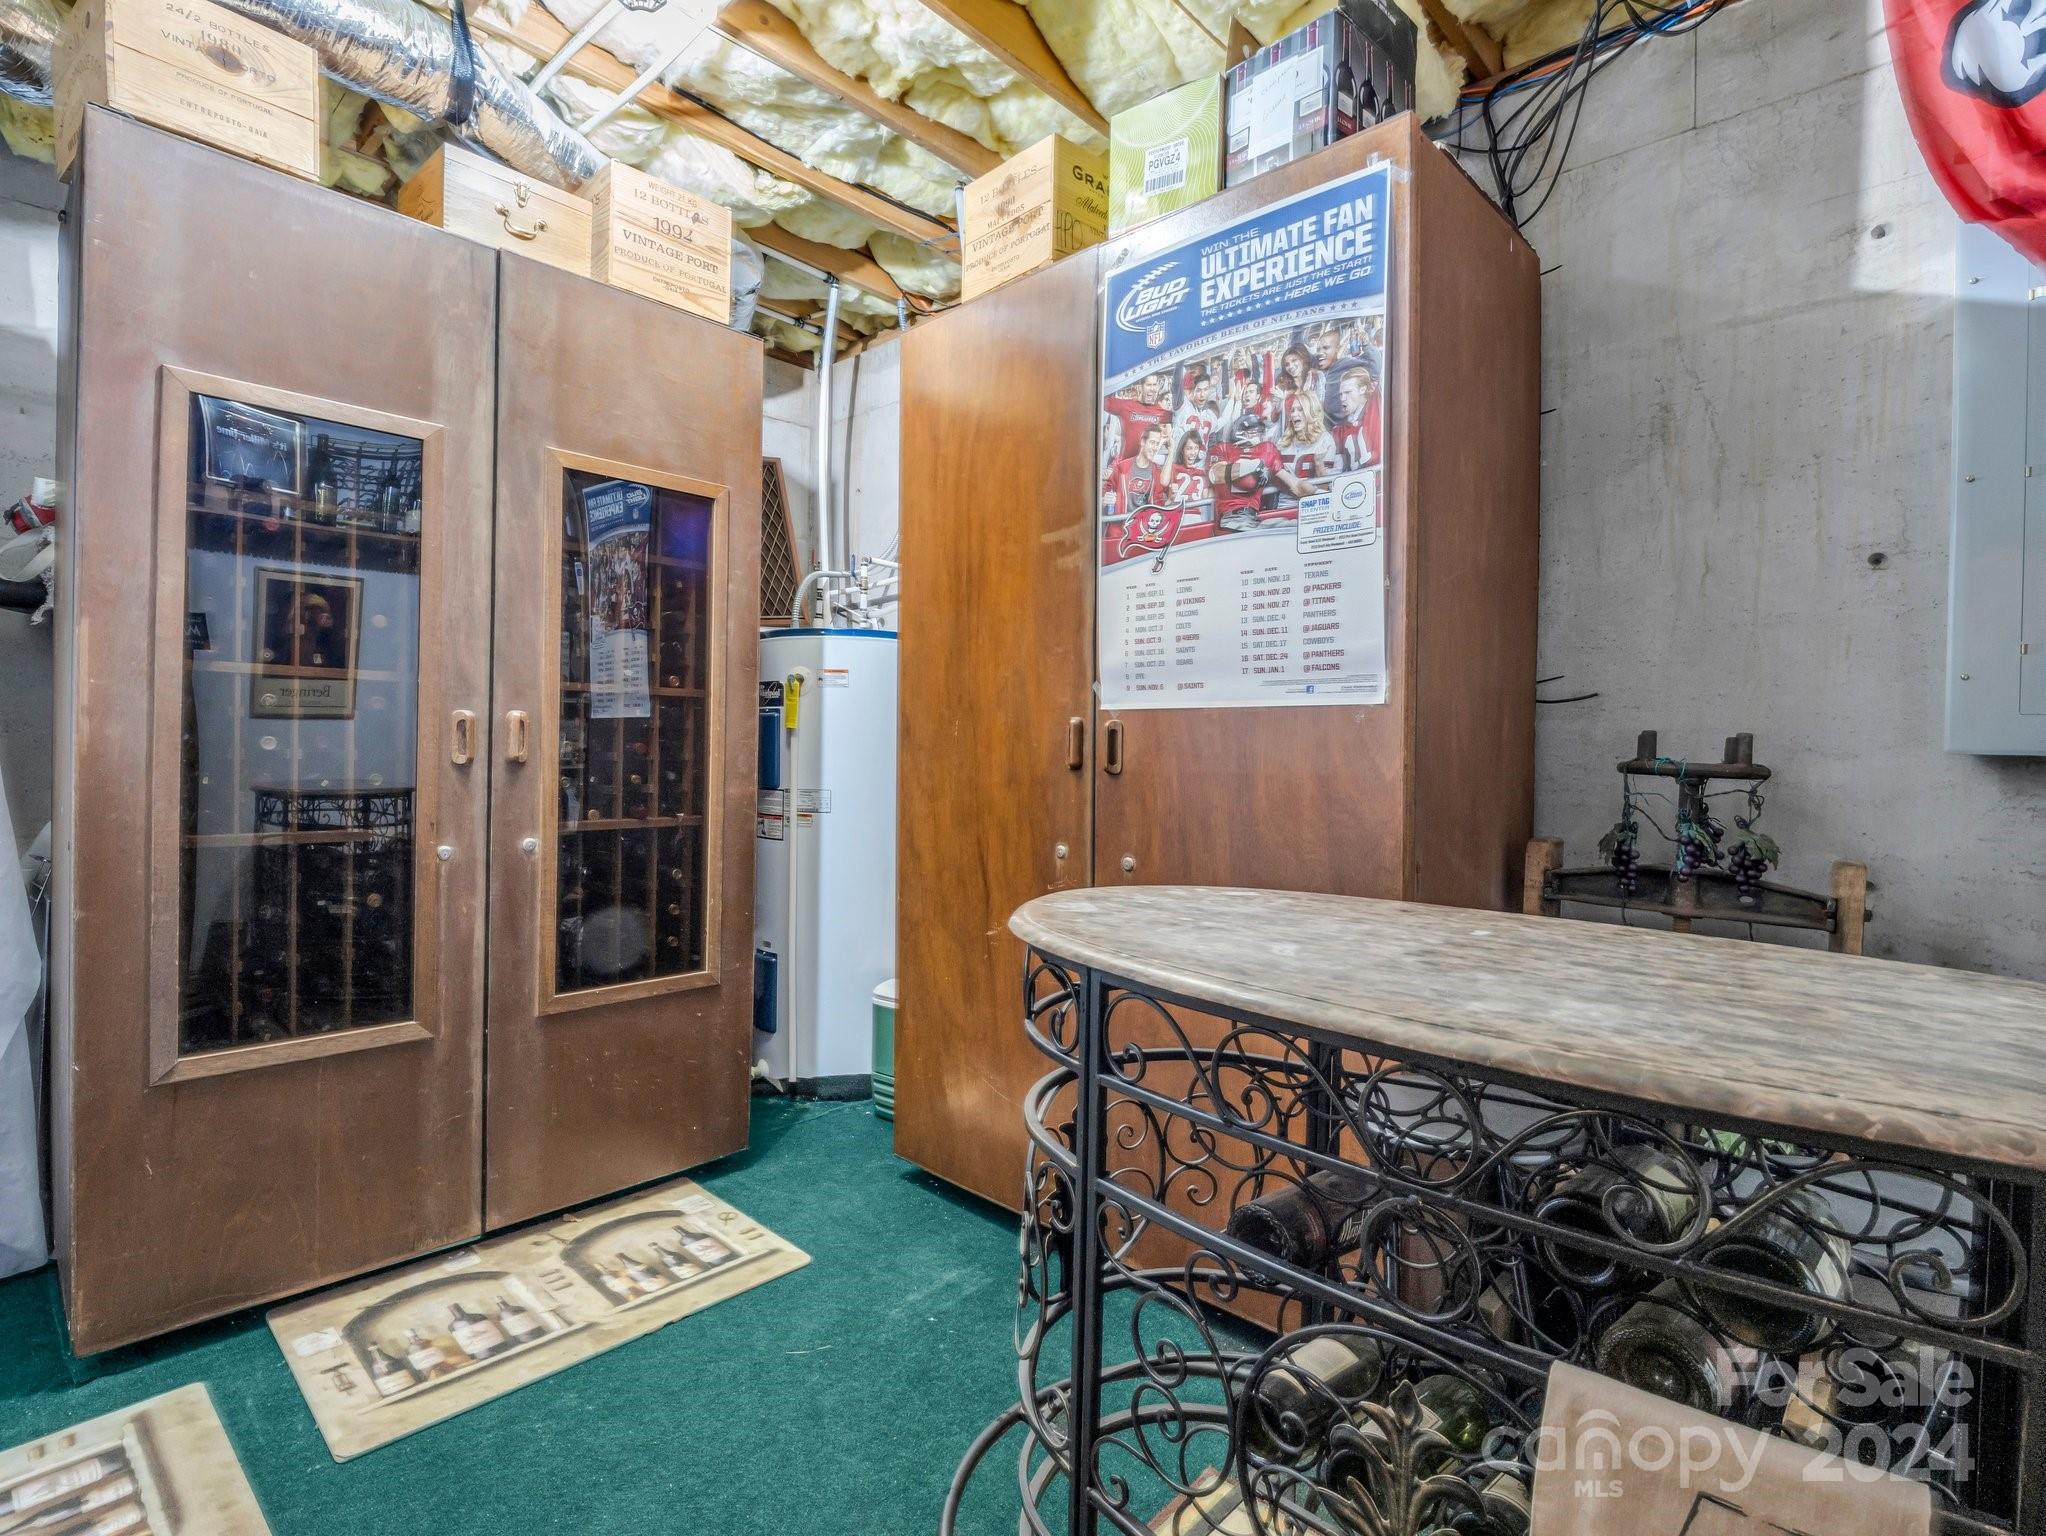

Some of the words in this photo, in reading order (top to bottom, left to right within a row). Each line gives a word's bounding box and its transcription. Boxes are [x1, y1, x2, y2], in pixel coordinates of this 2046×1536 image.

[209, 20, 271, 53] BOTTLES
[1149, 152, 1180, 170] PGVGZ4
[1072, 165, 1110, 197] GRA
[634, 188, 647, 200] 12
[651, 195, 709, 226] BOTTLS
[972, 216, 1021, 252] VINTAGE
[1018, 206, 1044, 226] PORT
[1201, 215, 1317, 280] ULTIMATE
[1323, 194, 1373, 236] FAN
[1202, 239, 1228, 256] WIN
[1232, 227, 1260, 243] THE
[623, 229, 683, 262] VINTAGE
[687, 255, 718, 274] PORT
[965, 248, 997, 272] PRODUCE
[999, 243, 1009, 255] OF
[1010, 223, 1050, 250] PORTUGAL
[614, 246, 660, 269] PRODUCE
[663, 264, 675, 273] OF
[679, 270, 726, 294] PORTUGAL
[1201, 222, 1373, 309] EXPERIENCE
[1135, 276, 1188, 305] BUD
[1202, 307, 1219, 318] THE
[1220, 292, 1261, 312] TICKETS
[1262, 284, 1282, 296] ARE
[1284, 277, 1309, 290] JUST
[1311, 267, 1331, 280] THE
[1284, 281, 1320, 301] HERE
[1324, 274, 1346, 288] WE
[1124, 288, 1191, 321] LIGHT
[1149, 333, 1163, 344] NFL
[1169, 333, 1218, 357] FAVORITE
[1220, 322, 1250, 338] BEER
[1252, 317, 1268, 329] OF
[1270, 311, 1294, 325] NFL
[1296, 306, 1326, 320] FANS
[1175, 472, 1203, 502] 23
[1301, 499, 1318, 508] SNAP
[1313, 525, 1335, 534] PRIZES
[1304, 570, 1329, 579] TEXANS
[1312, 582, 1341, 591] PACKERS
[1183, 597, 1206, 605] VIKINGS
[1281, 600, 1289, 608] 27
[1311, 596, 1336, 604] TITANS
[1303, 609, 1336, 618] PANTHERS
[1303, 636, 1335, 645] COWBOYS
[1311, 623, 1339, 631] JAGUARS
[1311, 649, 1344, 658] PANTHERS
[1311, 663, 1340, 671] FALCONS
